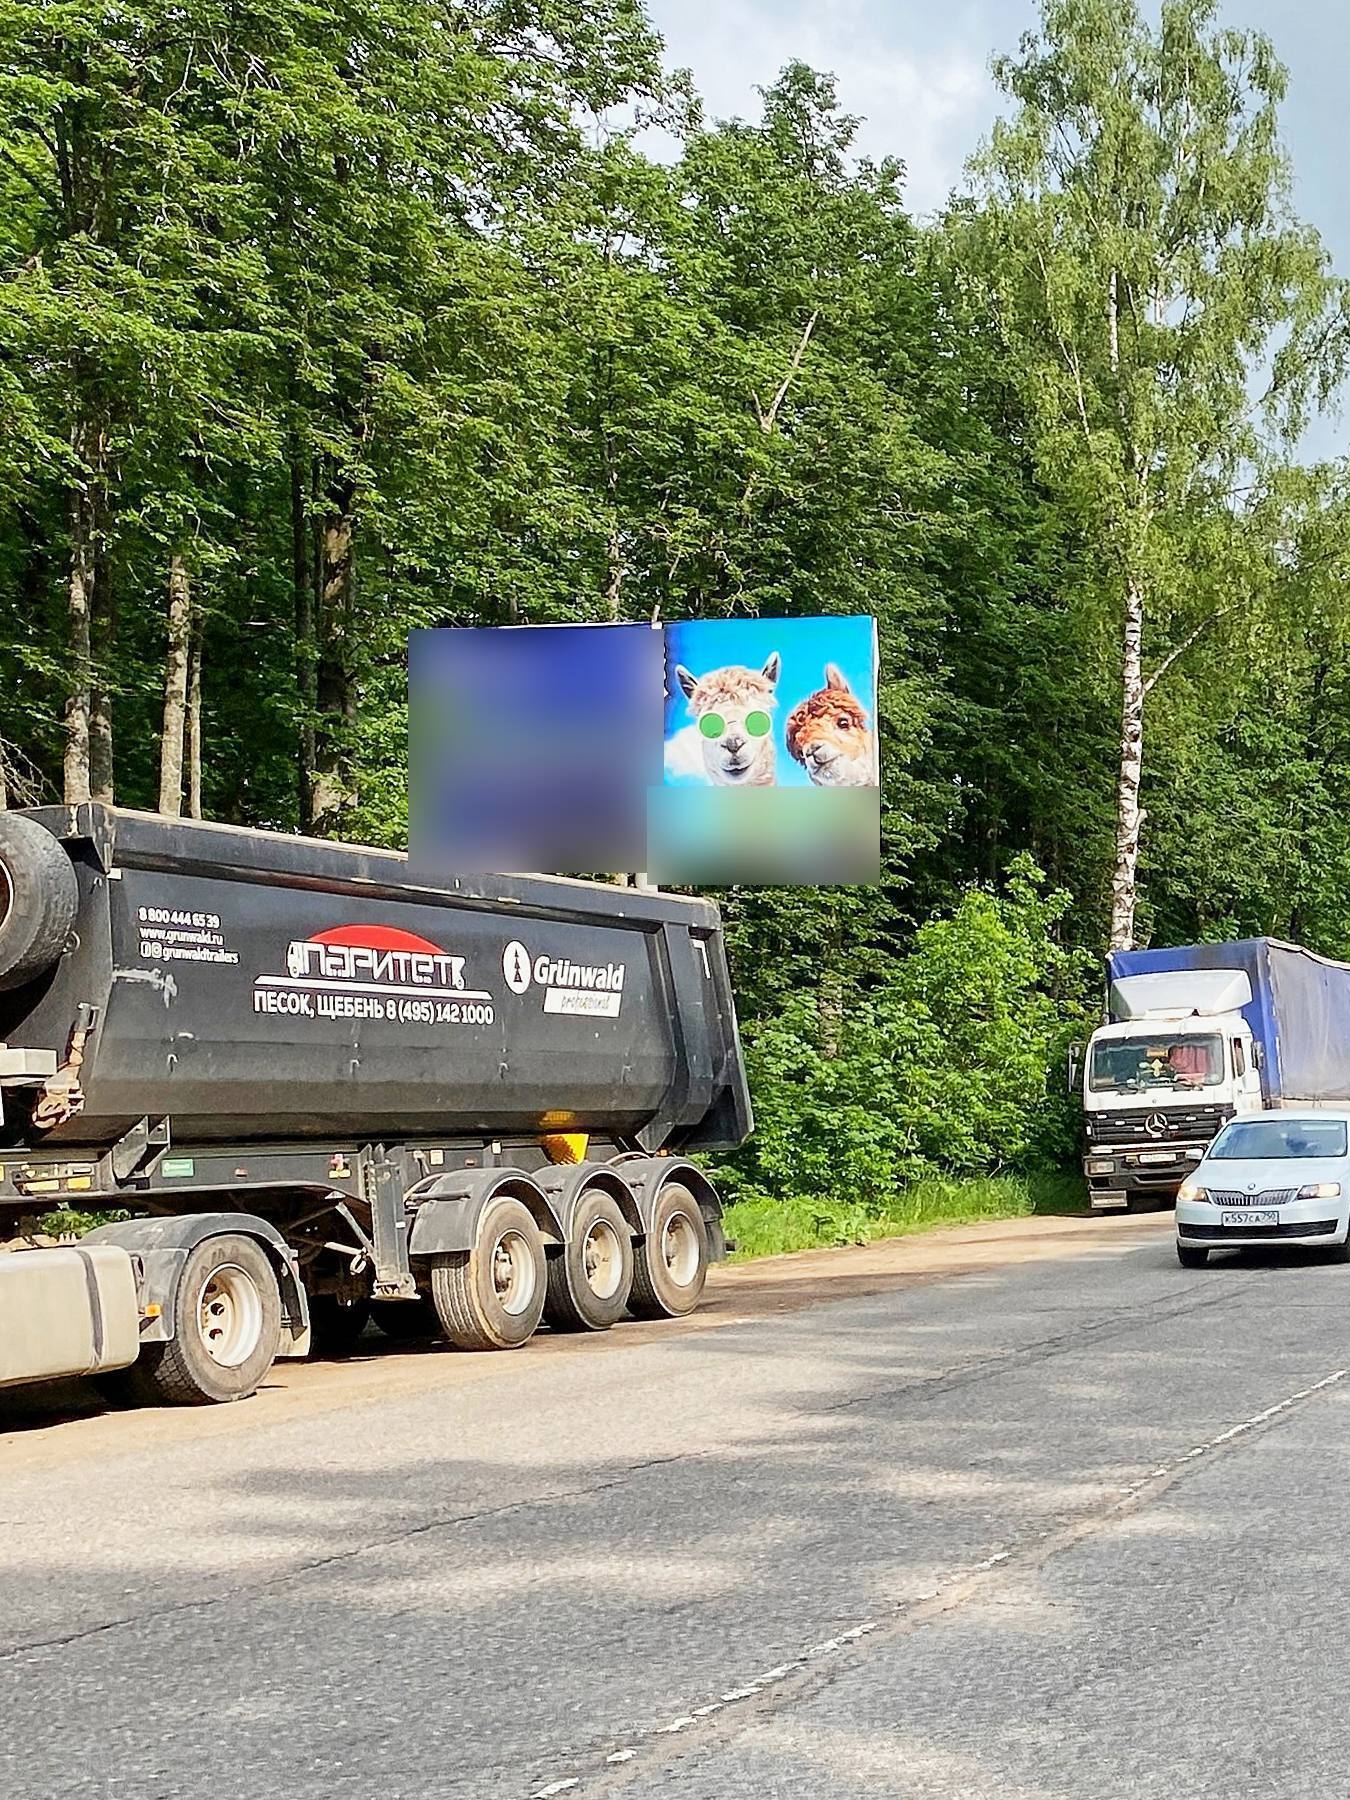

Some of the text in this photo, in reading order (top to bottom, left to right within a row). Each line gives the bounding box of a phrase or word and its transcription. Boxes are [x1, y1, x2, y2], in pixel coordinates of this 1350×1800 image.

[139, 907, 220, 929] 8 800 444 65 39
[140, 927, 224, 946] www.grunwald.ru
[533, 954, 625, 991] Grünwald
[254, 990, 494, 1025] ПЕСОК, ЩЕБЕНЬ 8 (495) 142 1000
